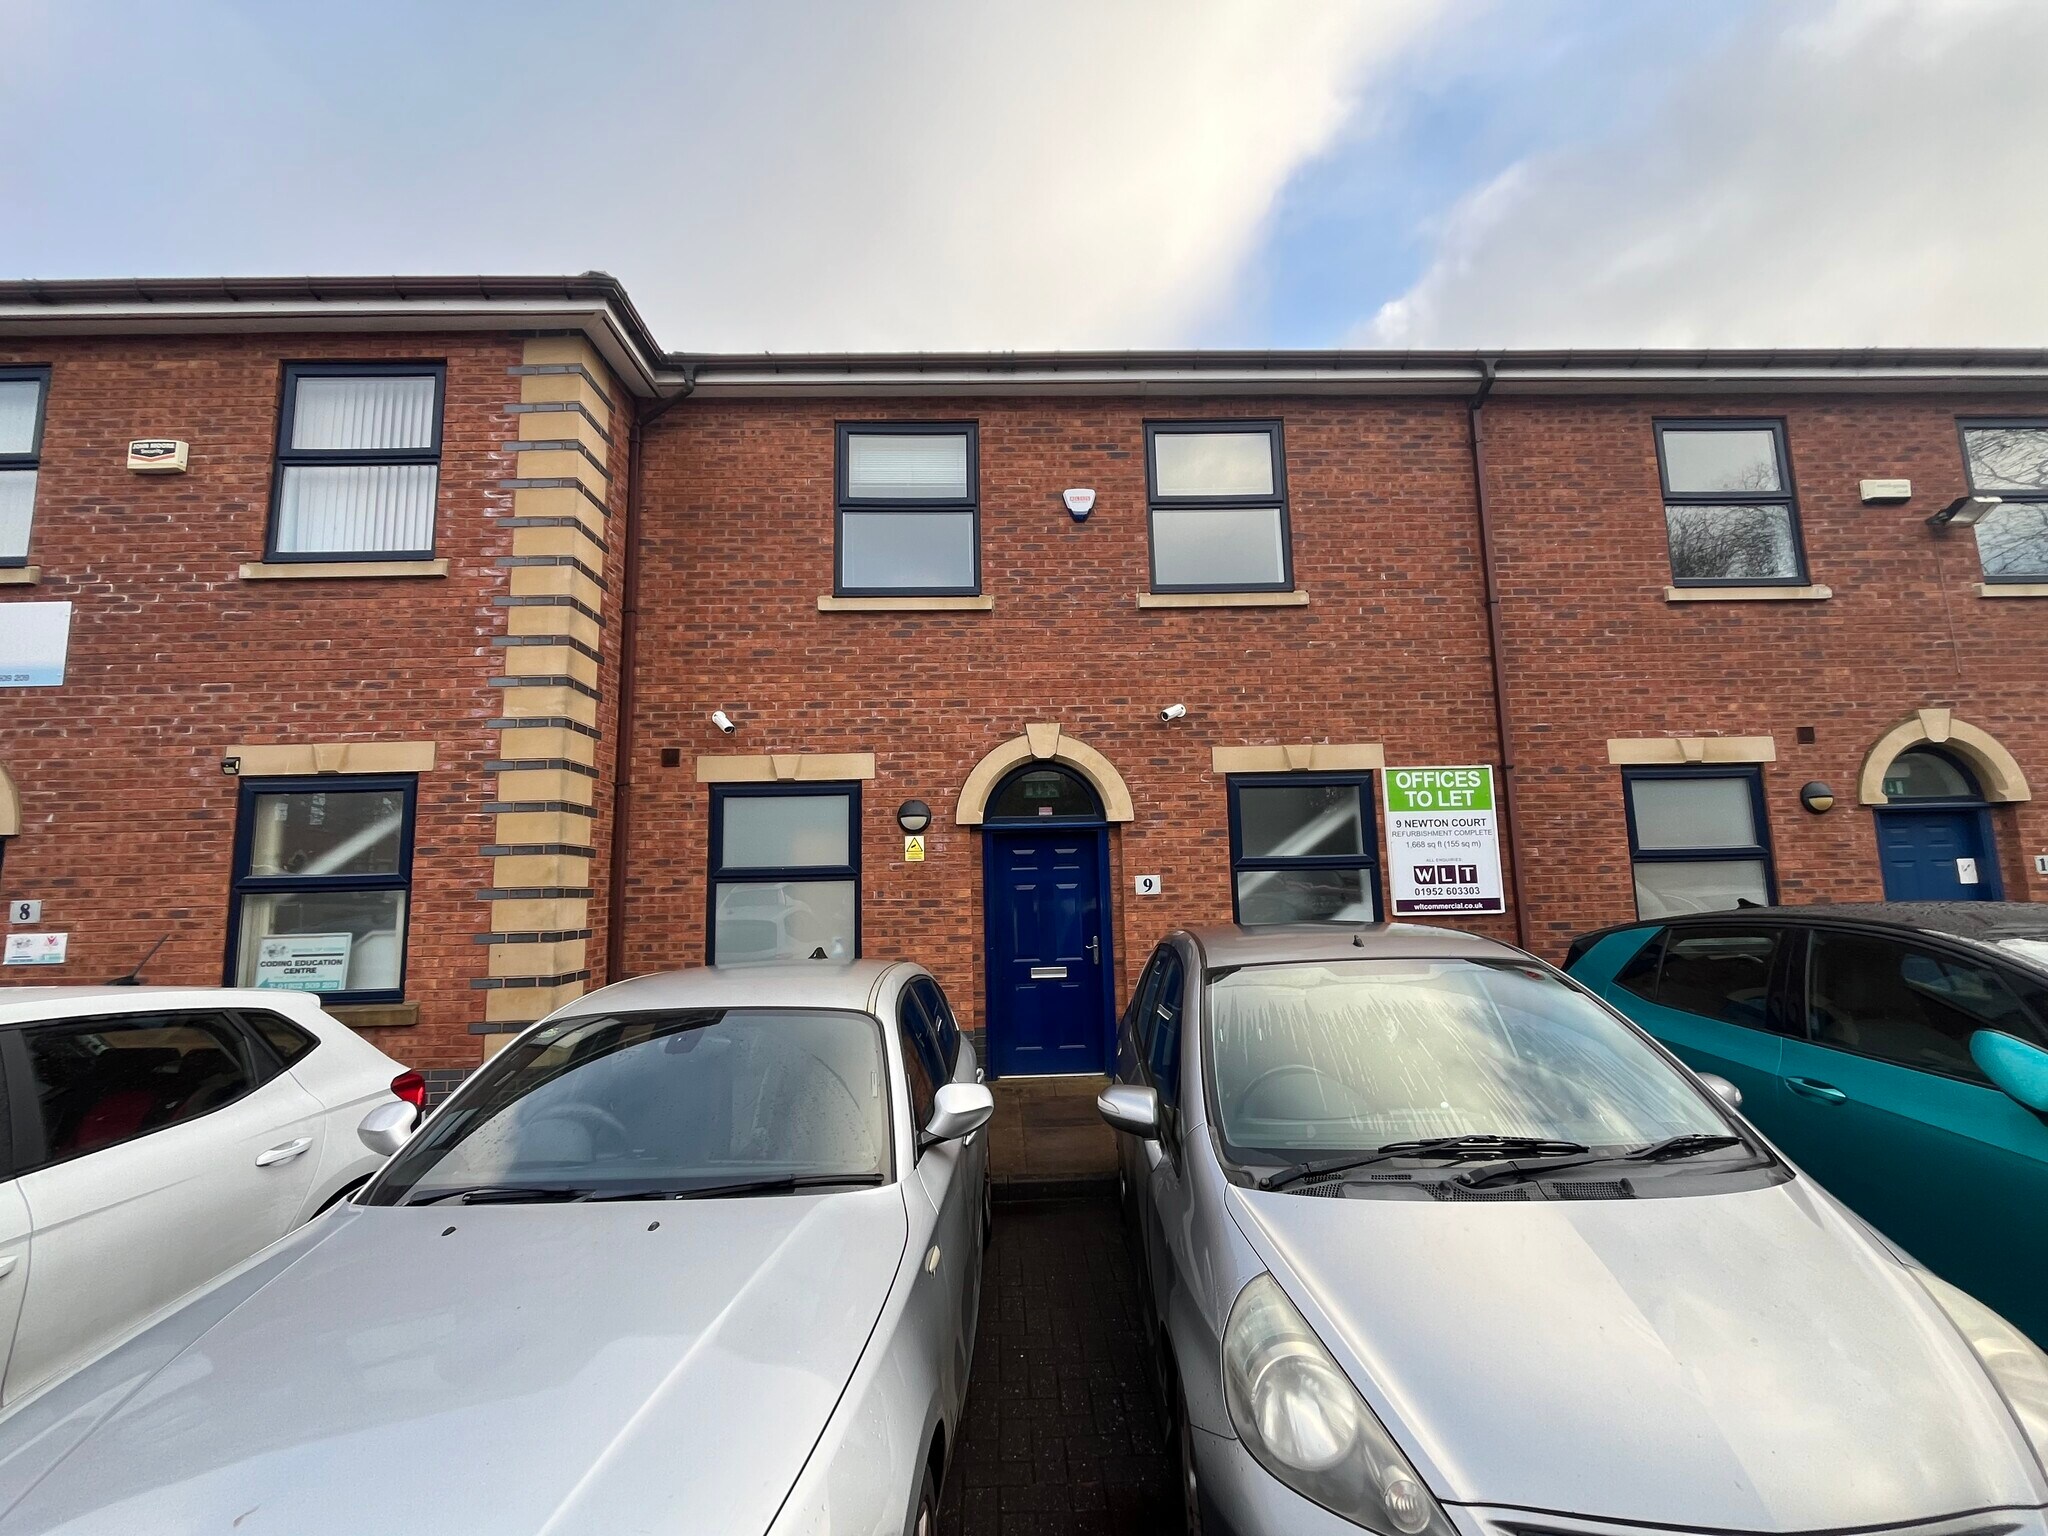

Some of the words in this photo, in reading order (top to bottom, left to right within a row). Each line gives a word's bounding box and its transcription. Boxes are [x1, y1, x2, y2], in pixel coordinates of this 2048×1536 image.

[1396, 771, 1481, 788] OFFICES
[1404, 790, 1433, 807] TO
[1437, 789, 1475, 807] LET
[1396, 820, 1402, 828] 9
[1404, 819, 1449, 828] NEWTON
[1451, 818, 1487, 827] COURT
[1414, 867, 1475, 882] WLT
[1143, 878, 1153, 893] 9
[1414, 888, 1443, 896] 01952
[1446, 886, 1480, 895] 603303
[19, 903, 30, 920] 8
[1413, 902, 1484, 911] wltcommercial.co.uk
[260, 960, 293, 968] CODING
[294, 959, 343, 967] EDUCATION
[283, 967, 317, 975] CENTRE
